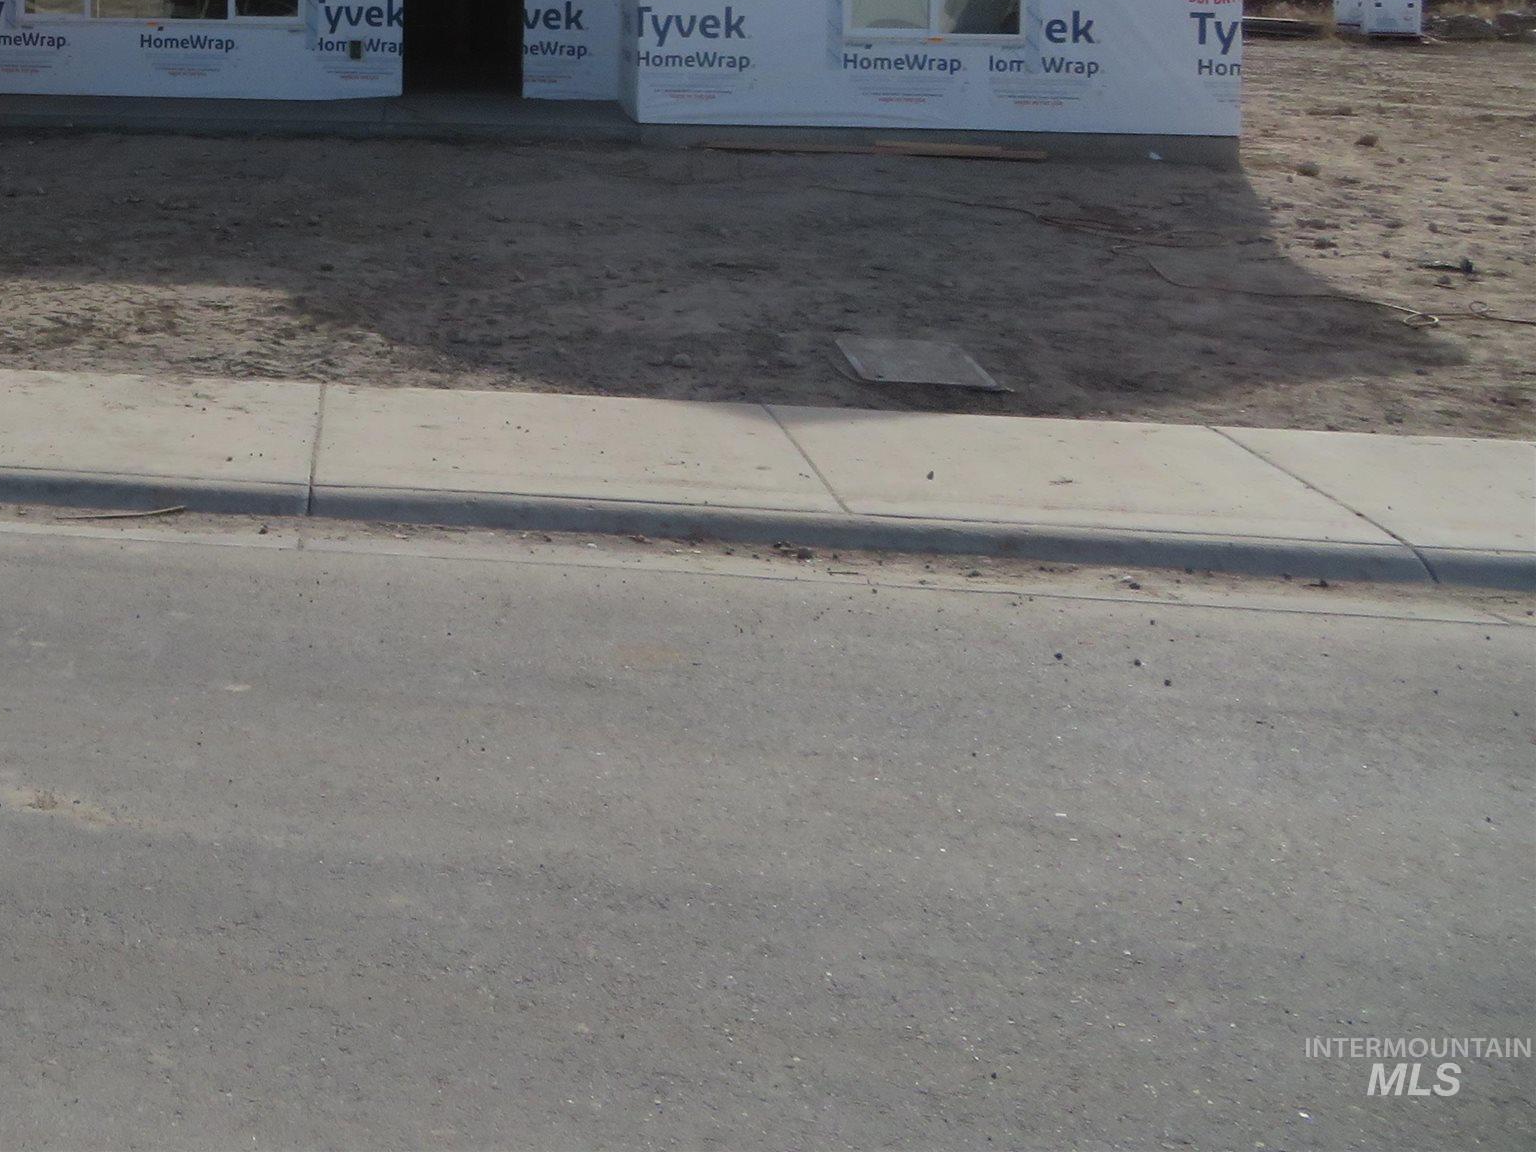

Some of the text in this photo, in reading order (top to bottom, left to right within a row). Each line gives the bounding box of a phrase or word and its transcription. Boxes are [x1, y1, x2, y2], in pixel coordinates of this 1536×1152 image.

[522, 1, 584, 30] vek
[637, 6, 746, 48] Tyvek
[140, 33, 235, 53] HomeWrap
[522, 41, 588, 59] eWrap
[637, 51, 750, 72] HomeWrap
[843, 52, 962, 74] HomeWrap
